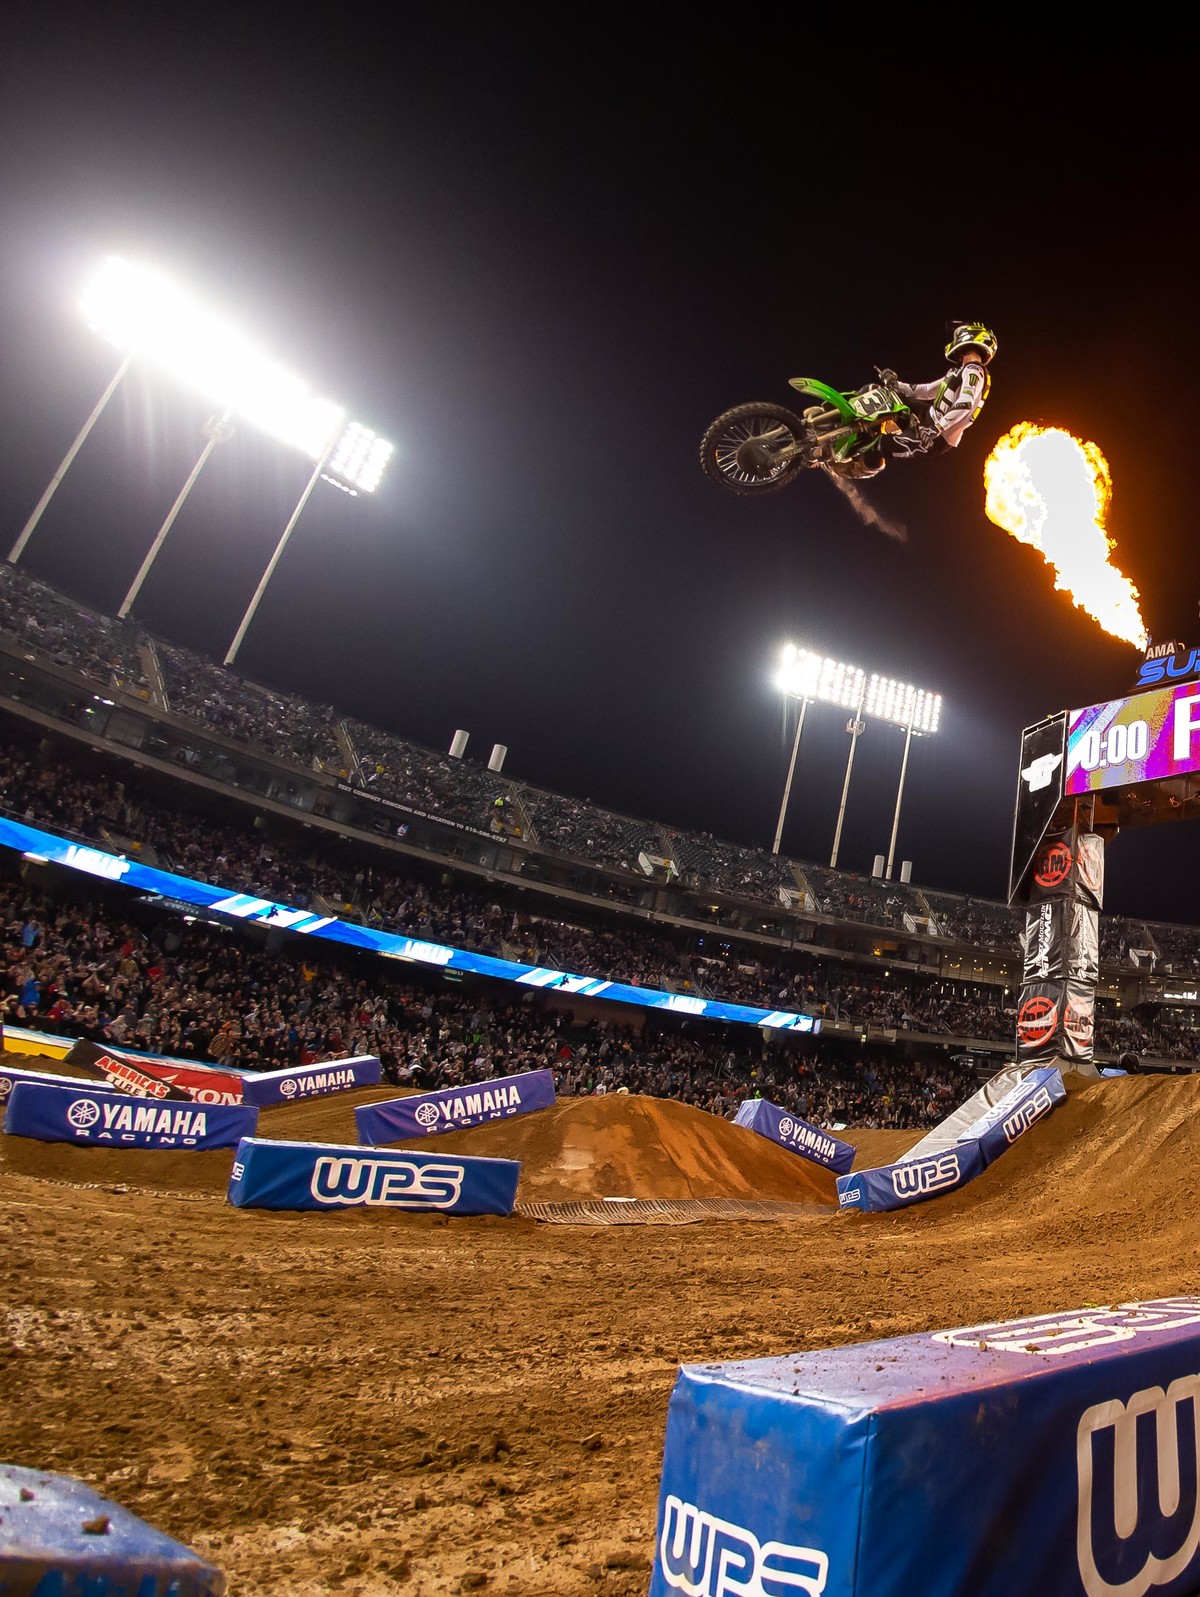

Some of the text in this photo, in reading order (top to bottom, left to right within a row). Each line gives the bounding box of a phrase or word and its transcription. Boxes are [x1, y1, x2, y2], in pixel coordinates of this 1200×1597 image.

[1145, 642, 1176, 660] AMA
[427, 813, 455, 827] LOCATION
[94, 1055, 171, 1099] AMERICA'S
[110, 1075, 141, 1096] TIRE
[287, 1083, 352, 1099] RACING
[297, 1069, 356, 1093] YAMAHA
[439, 1085, 522, 1122] YAMAHA
[1002, 1086, 1052, 1144] WPS
[103, 1103, 207, 1137] YAMAHA
[426, 1107, 518, 1133] RACING
[75, 1128, 198, 1145] RACING
[780, 1135, 829, 1163] RACING
[792, 1123, 836, 1159] YAMAHA
[311, 1157, 465, 1209] WPS
[892, 1153, 961, 1199] WPS
[838, 1188, 861, 1205] WPS
[660, 1494, 829, 1597] WPS
